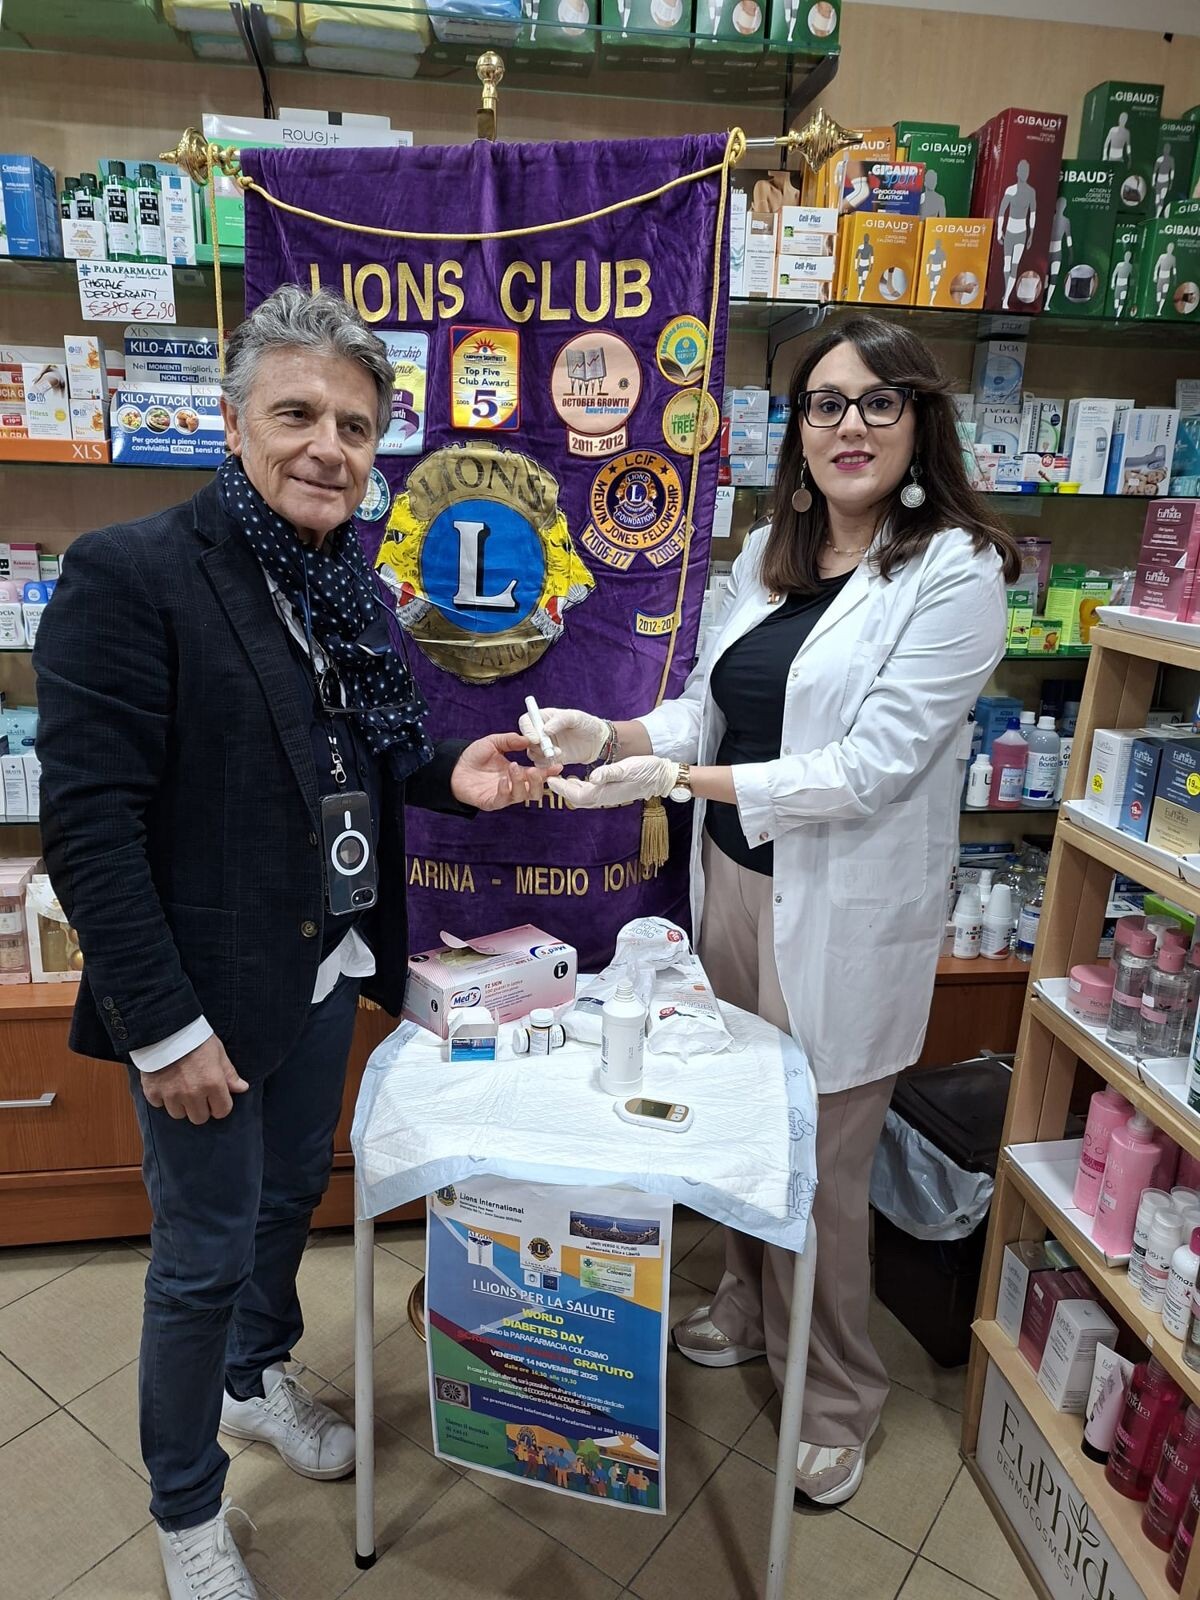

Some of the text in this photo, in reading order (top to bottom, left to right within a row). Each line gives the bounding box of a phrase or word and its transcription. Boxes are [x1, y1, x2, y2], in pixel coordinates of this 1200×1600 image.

[1115, 91, 1155, 104] GIBAUD
[1017, 114, 1057, 128] GIBAUD
[1161, 123, 1192, 132] GIBAUD
[921, 142, 967, 153] GIBAUD
[872, 164, 919, 176] GIBAUD
[1179, 203, 1200, 214] GIB
[866, 220, 909, 230] GIBAUD
[935, 224, 982, 234] GIBAUD
[94, 265, 168, 276] PARAFARMACIA
[500, 258, 652, 323] CLUB
[131, 302, 175, 320] €2,90
[130, 342, 213, 356] KILO-ATTACK
[385, 345, 422, 363] bership
[999, 343, 1019, 353] LYCIA
[148, 363, 181, 371] MOMENTI
[392, 362, 415, 375] llence
[464, 367, 501, 376] Top Five
[458, 377, 510, 388] Club Award
[120, 394, 188, 407] KILO-ATTACK
[472, 389, 498, 419] 5
[561, 397, 630, 408] OCTOBER GROWTH
[585, 407, 629, 415] Award Program
[1041, 403, 1057, 413] CIA
[993, 415, 1019, 425] LYCIA
[671, 422, 695, 435] TREE
[572, 433, 624, 453] 2011-2012
[72, 444, 102, 460] XLS
[624, 453, 657, 467] LCIF
[418, 456, 547, 512] LIONS
[631, 485, 642, 503] L
[716, 490, 731, 498] CIA
[593, 479, 680, 545] MELVIN JONES FELLOWSHIP
[616, 511, 655, 525] FOUNDATION
[584, 529, 632, 568] 2006-07
[453, 520, 519, 609] L
[406, 857, 476, 894] ARINA
[516, 865, 590, 897] MEDIO
[453, 992, 477, 1006] Med's
[459, 1192, 478, 1204] Lions
[479, 1198, 525, 1214] International
[1171, 1268, 1194, 1288] ermas
[480, 1280, 517, 1299] LIONS
[520, 1290, 545, 1305] PER
[548, 1296, 563, 1309] LA
[566, 1299, 616, 1321] SALUTE
[521, 1309, 564, 1325] WORLD
[503, 1318, 585, 1345] DIABETES DAY
[510, 1332, 569, 1351] PARAFARMACIA
[568, 1344, 609, 1361] COLOSIMO
[535, 1359, 580, 1376] NOVEMBRE
[580, 1372, 599, 1381] 2025
[573, 1358, 635, 1379] GRATUITO
[560, 1375, 578, 1385] 19,30
[999, 1400, 1118, 1600] EuPhid
[996, 1449, 1075, 1587] DERMOCOSMESI
